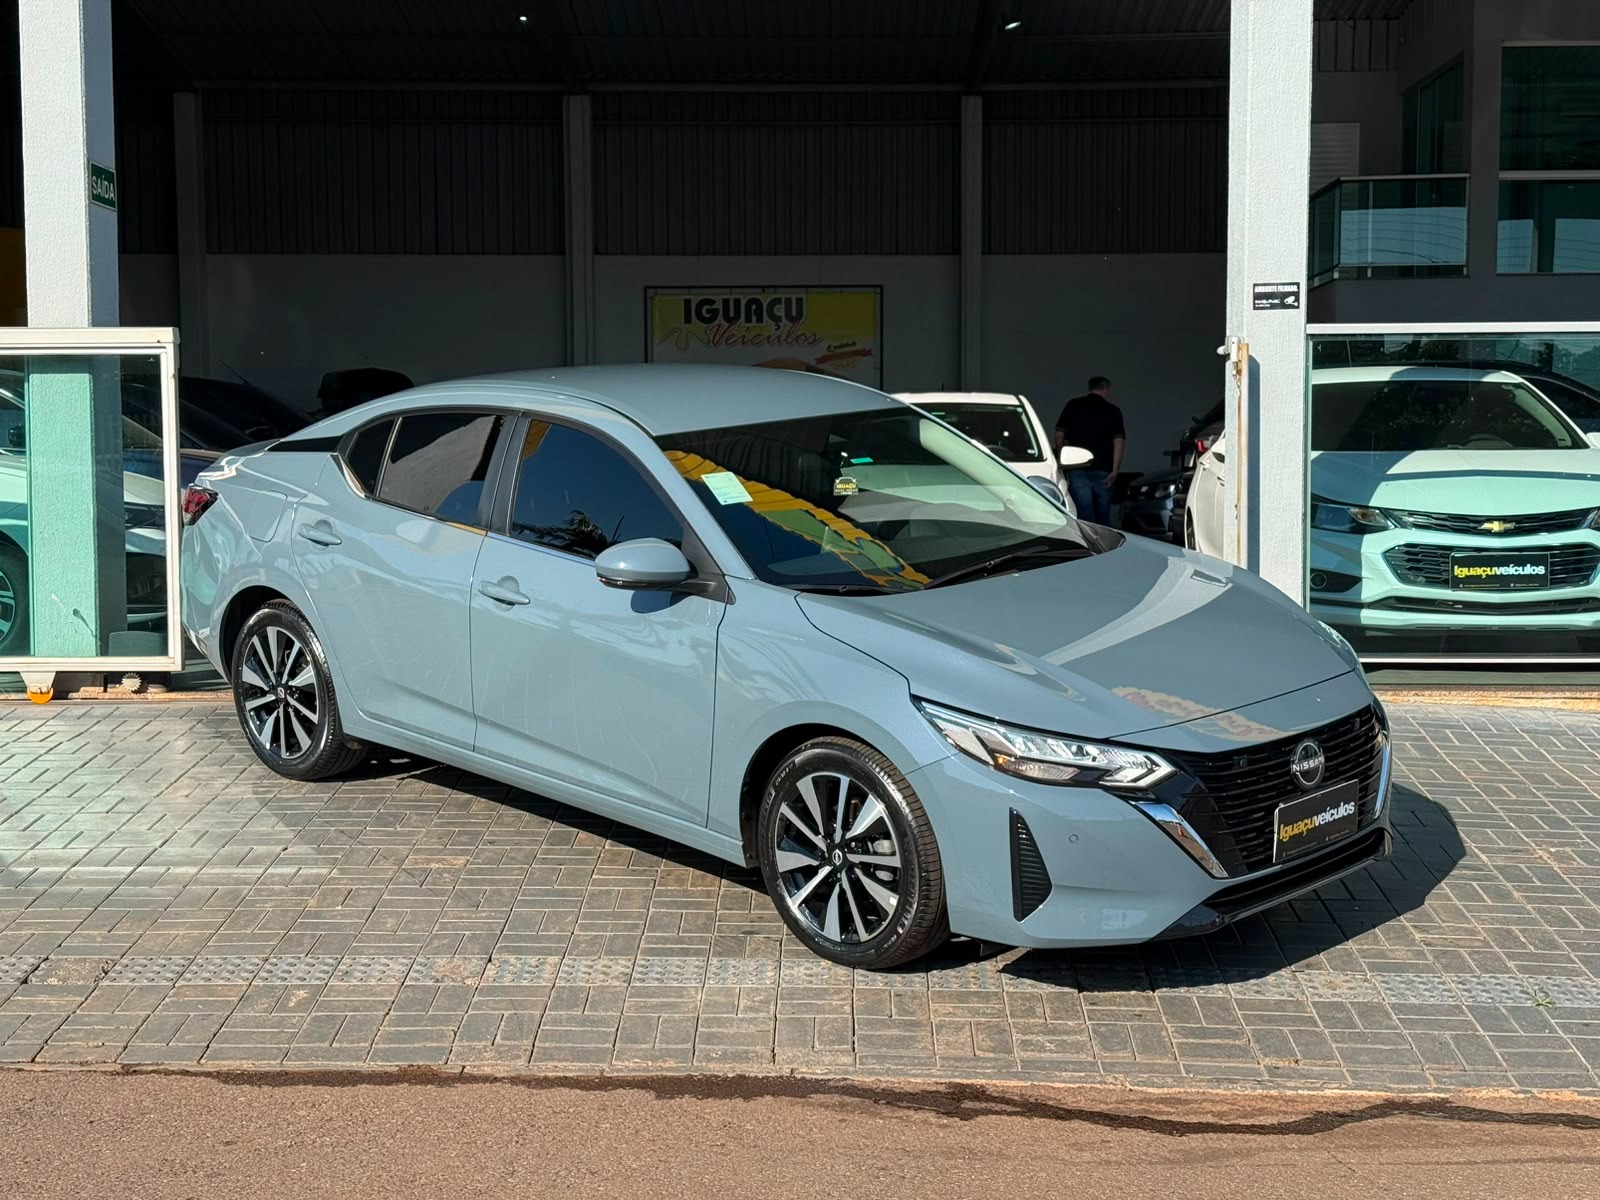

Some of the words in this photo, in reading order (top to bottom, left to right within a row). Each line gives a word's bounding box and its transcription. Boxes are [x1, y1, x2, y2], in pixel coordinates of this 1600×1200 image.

[92, 174, 115, 200] SAÍDA
[683, 296, 804, 331] IGUAÇU
[708, 321, 825, 348] Veículos
[1453, 564, 1546, 579] Iguaçuveículos
[1280, 801, 1355, 842] Iguaçuveículos
